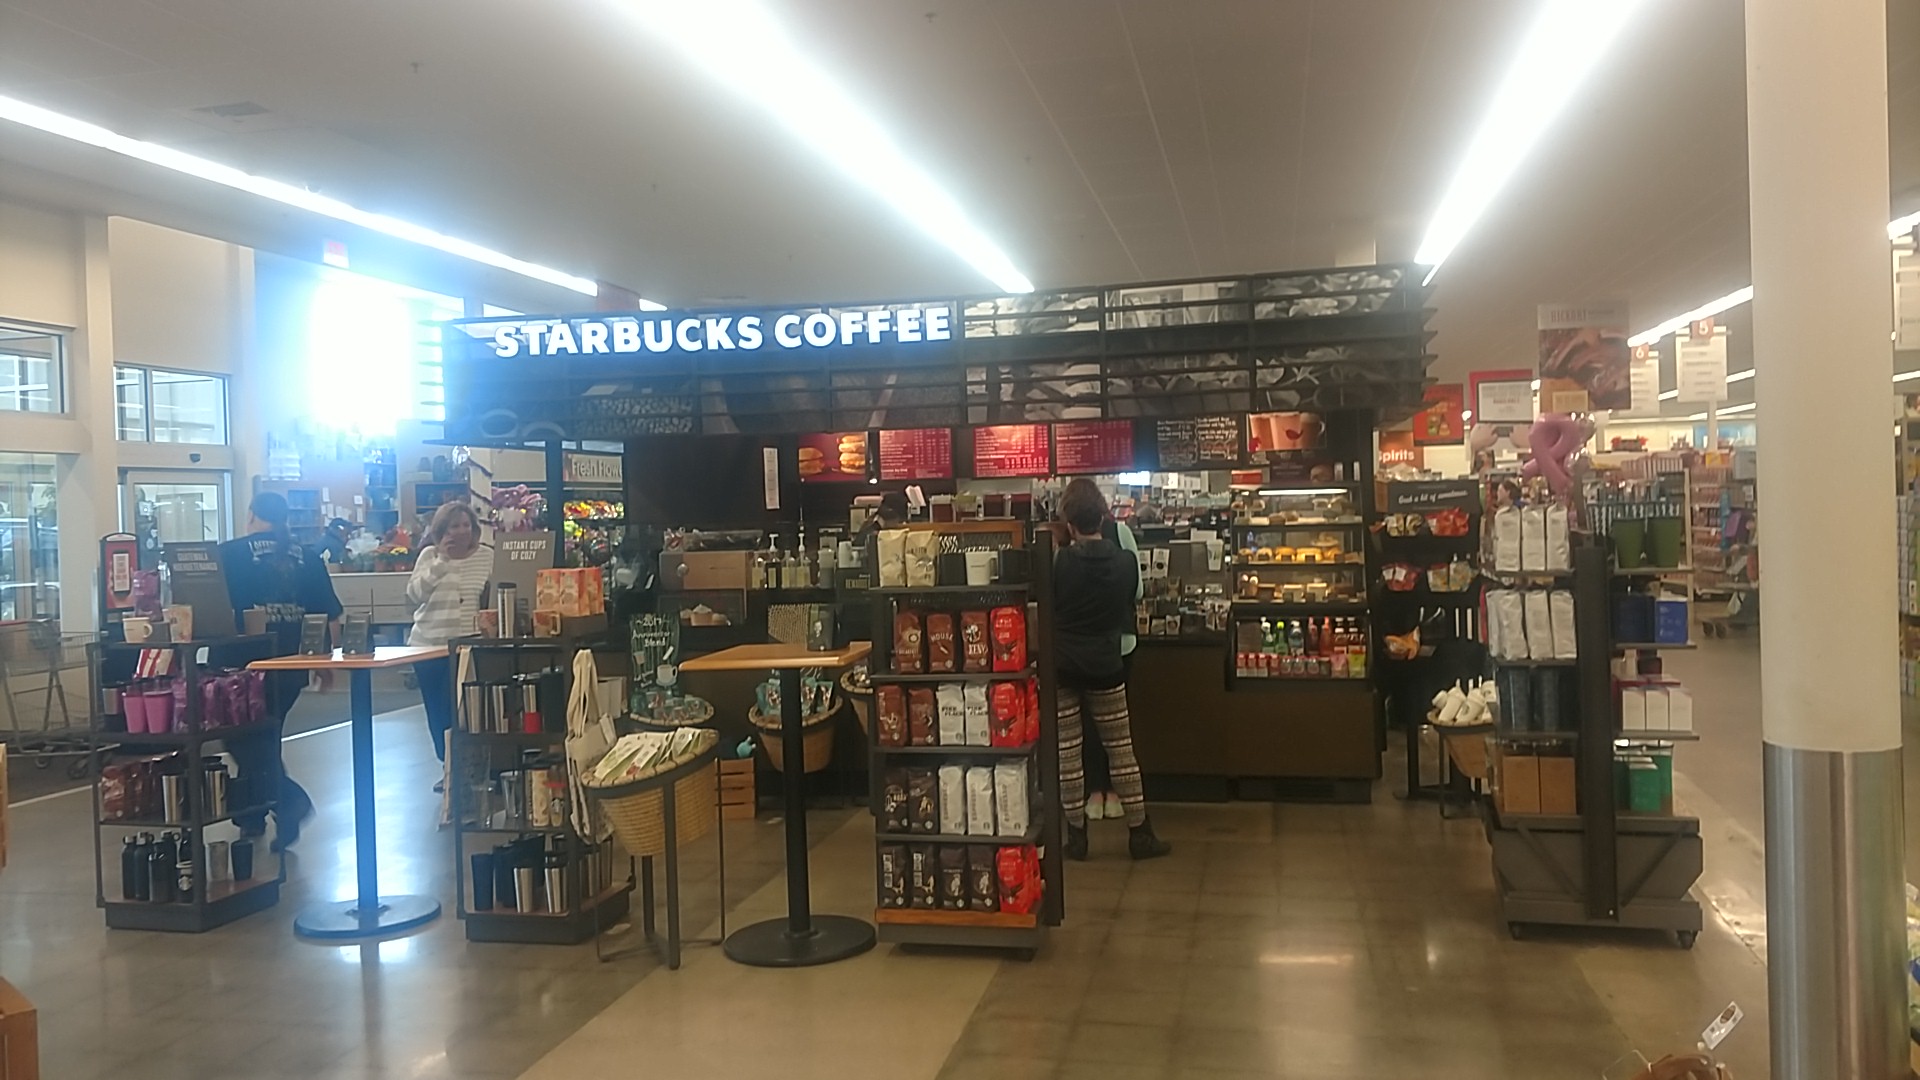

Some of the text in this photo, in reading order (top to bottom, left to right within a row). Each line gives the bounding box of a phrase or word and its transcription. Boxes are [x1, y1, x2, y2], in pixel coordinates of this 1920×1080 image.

[494, 305, 952, 358] STARBUCKS COFFEE
[571, 458, 597, 477] Fresh
[502, 540, 547, 551] INSTANT CUPS
[511, 550, 537, 561] OF COZY
[644, 637, 666, 648] Blend
[930, 632, 954, 643] HOUSE
